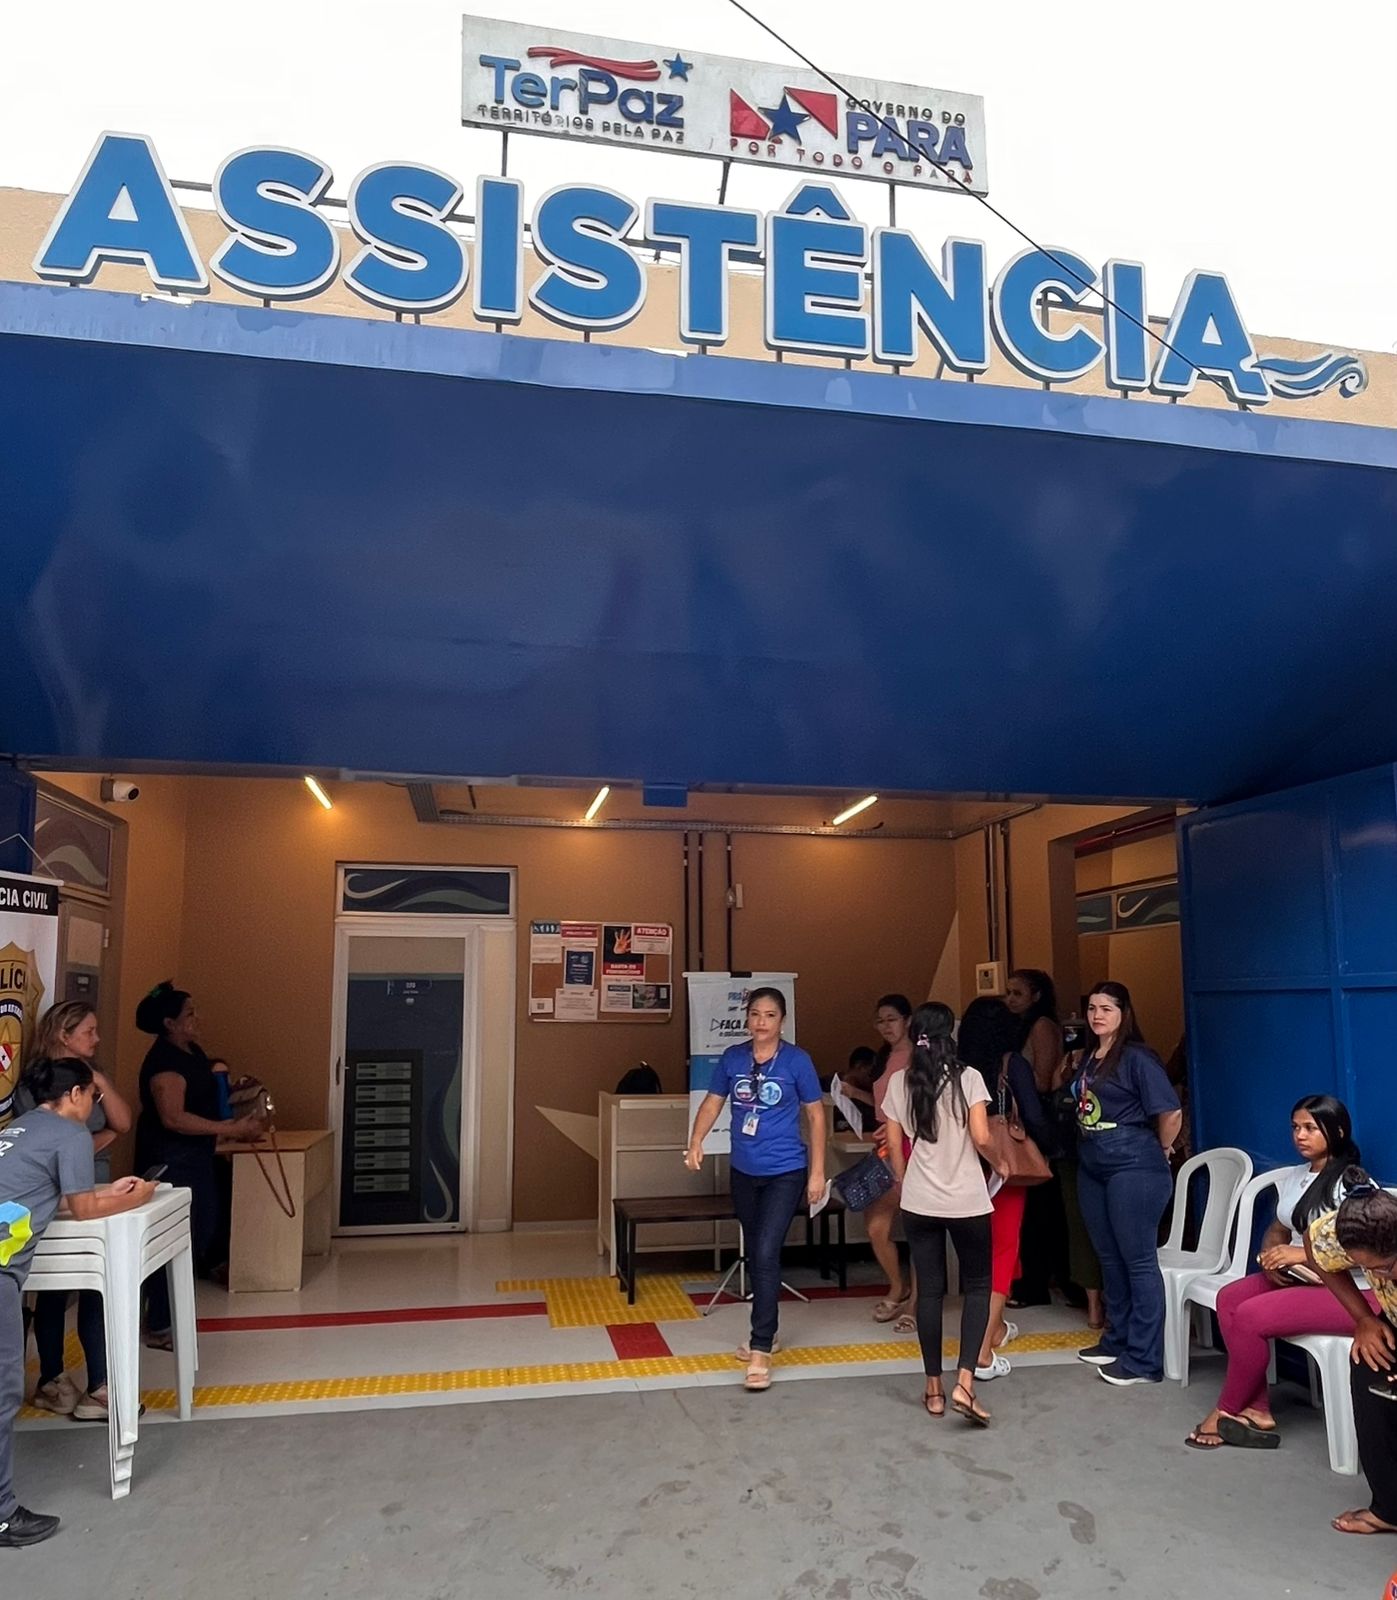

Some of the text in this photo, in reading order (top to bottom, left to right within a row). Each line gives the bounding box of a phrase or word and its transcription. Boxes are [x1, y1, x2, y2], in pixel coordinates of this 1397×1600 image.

[479, 54, 685, 128] TerPaz
[846, 98, 966, 126] GOVERNO DO
[602, 121, 645, 139] PELA
[651, 128, 685, 144] PAZ
[730, 138, 777, 158] POR
[797, 148, 863, 170] TODO
[884, 161, 894, 174] O
[32, 130, 1273, 404] ASSISTÊNCIA
[22, 890, 49, 910] CIVIL
